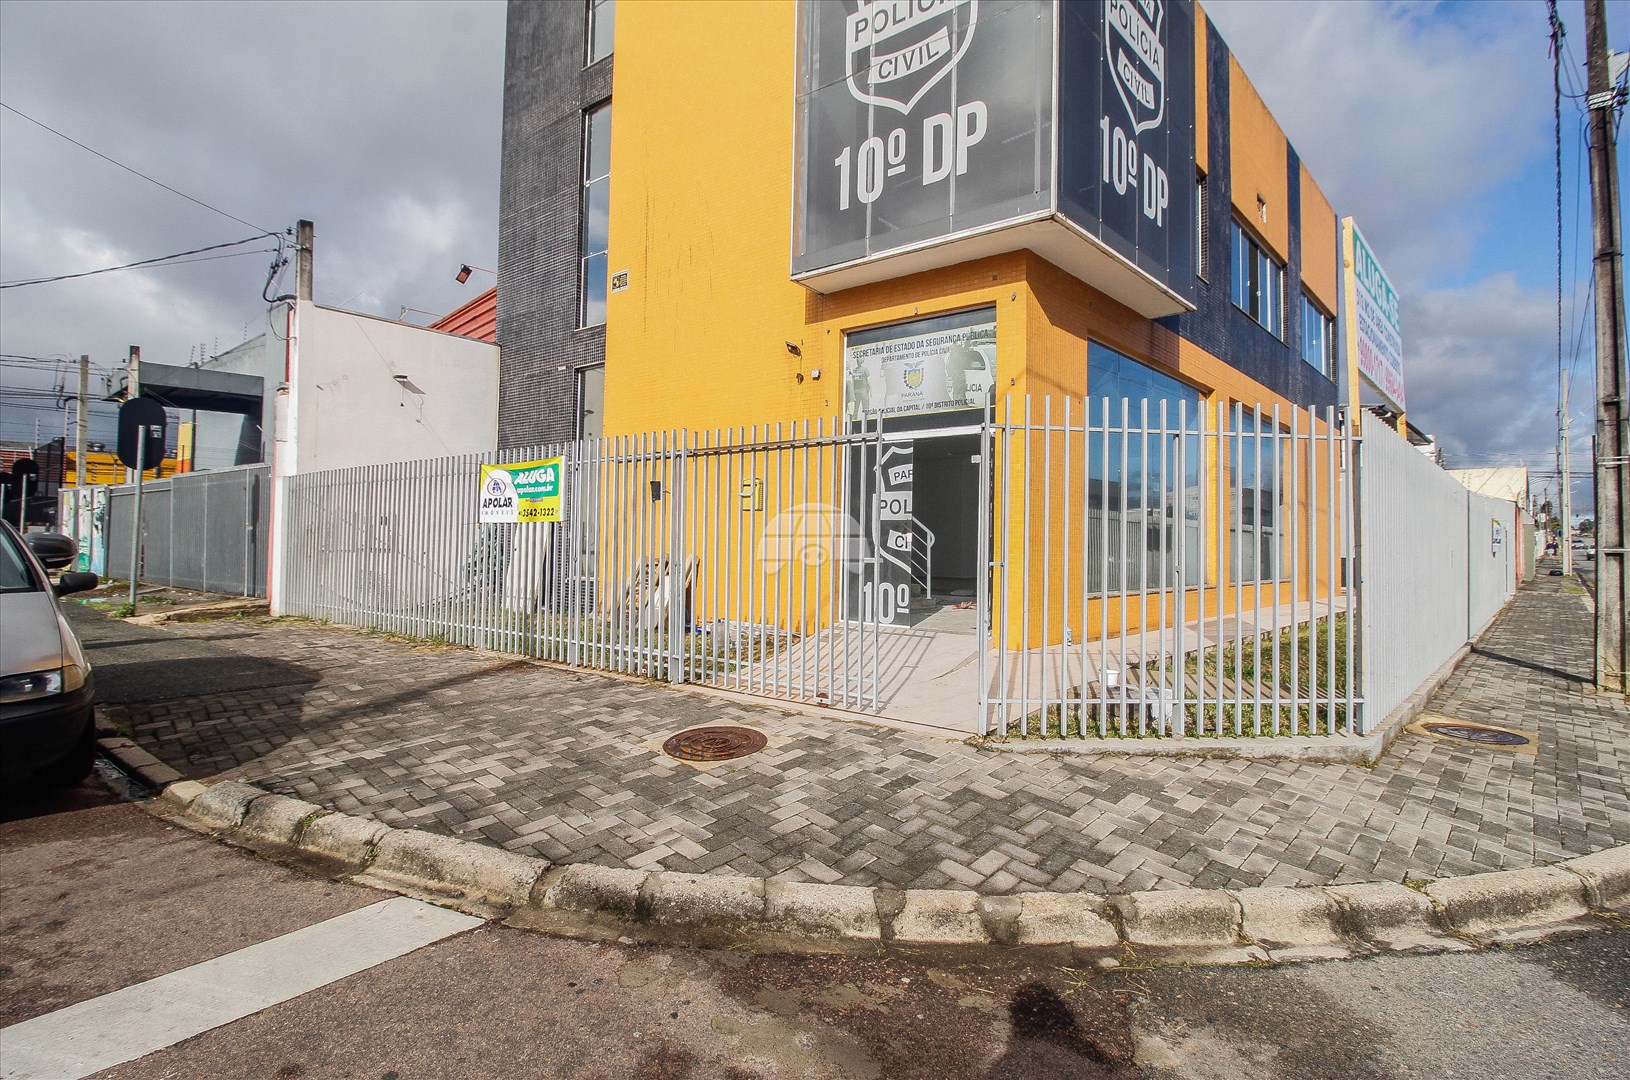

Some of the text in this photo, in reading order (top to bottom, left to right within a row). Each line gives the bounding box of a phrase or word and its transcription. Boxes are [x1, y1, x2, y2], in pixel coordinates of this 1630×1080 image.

[878, 42, 940, 79] CIVIL
[1123, 63, 1151, 104] CIVIL
[834, 100, 988, 210] 10º DP
[1100, 115, 1169, 228] 10º DP
[853, 346, 885, 359] SECRETARIA
[886, 344, 893, 354] DE
[894, 341, 915, 353] ESTADO
[916, 340, 924, 349] DA
[925, 333, 961, 348] SEGURANÇA
[881, 352, 914, 363] DEPARTAMENTO
[903, 403, 920, 412] CAPITAL
[934, 399, 954, 408] DISTRITO
[514, 467, 555, 485] ALUGA
[516, 483, 554, 495] apolar.com.br
[482, 497, 513, 508] APOLAR
[522, 507, 555, 517] 3542-1322
